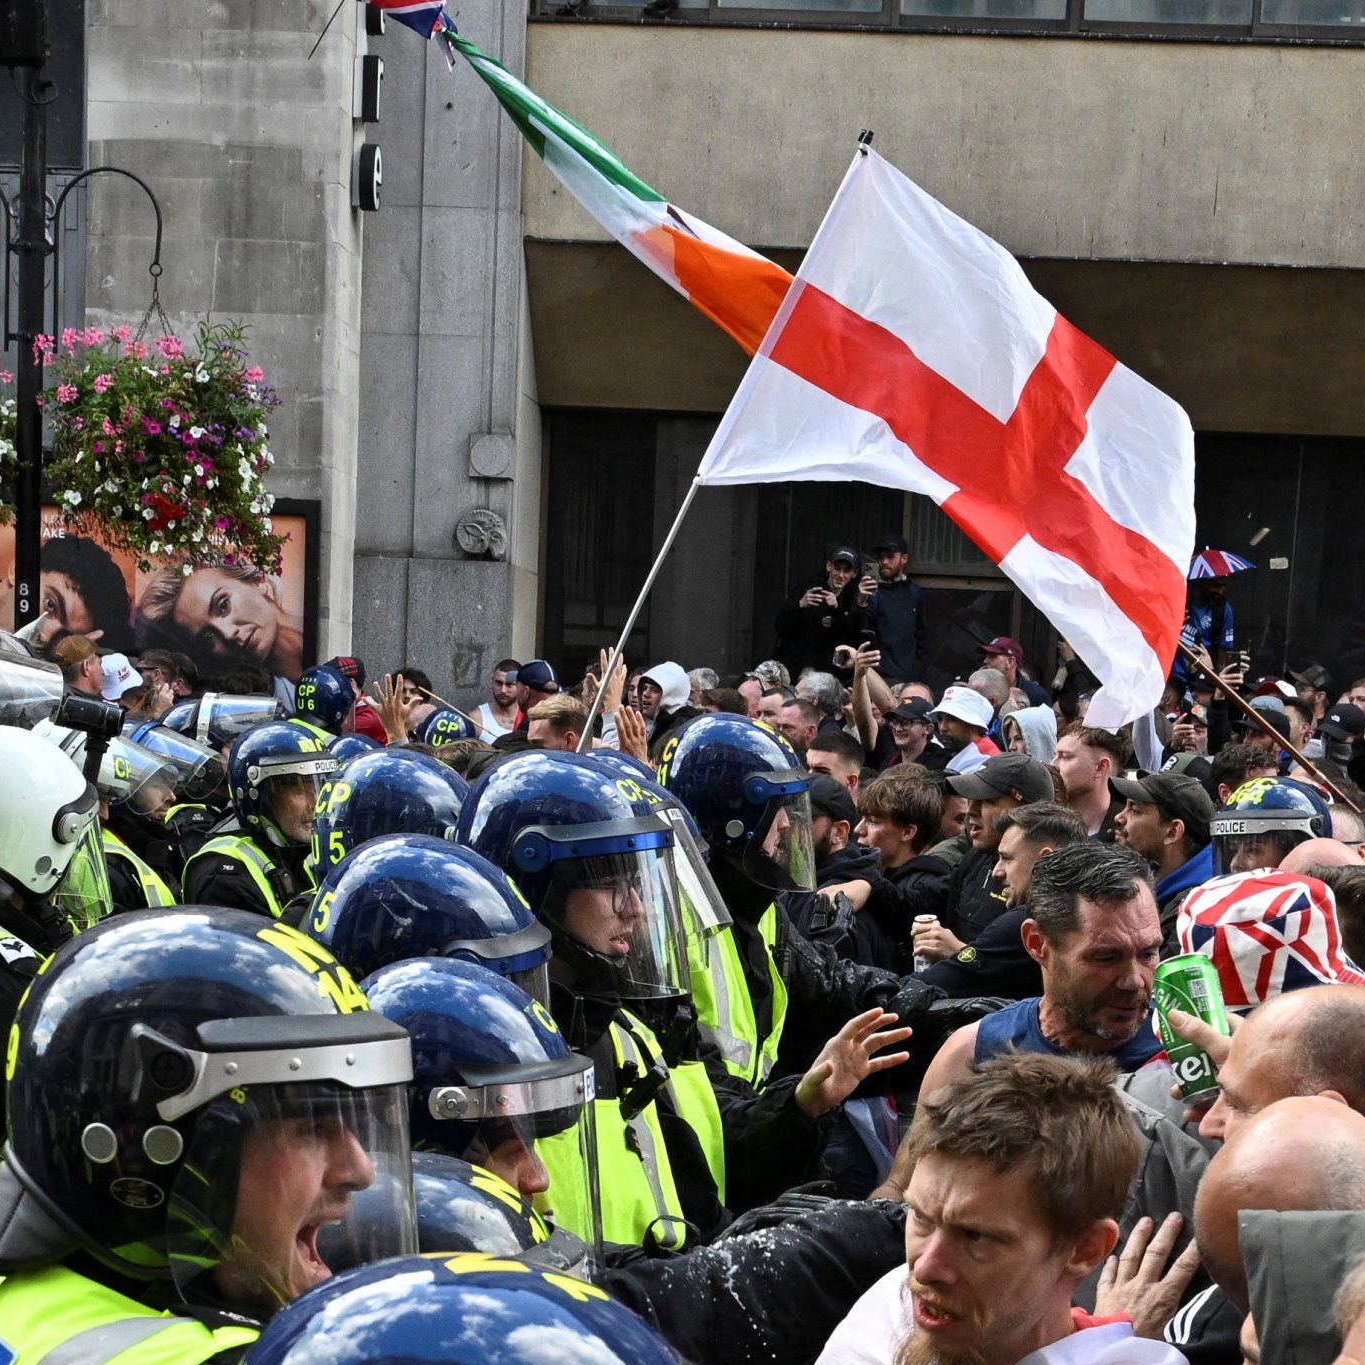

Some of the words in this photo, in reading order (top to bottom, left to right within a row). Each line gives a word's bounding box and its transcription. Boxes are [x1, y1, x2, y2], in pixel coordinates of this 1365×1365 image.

[298, 684, 316, 697] CP
[436, 718, 459, 734] CP
[315, 781, 352, 815] CP
[1215, 821, 1246, 834] POLICE
